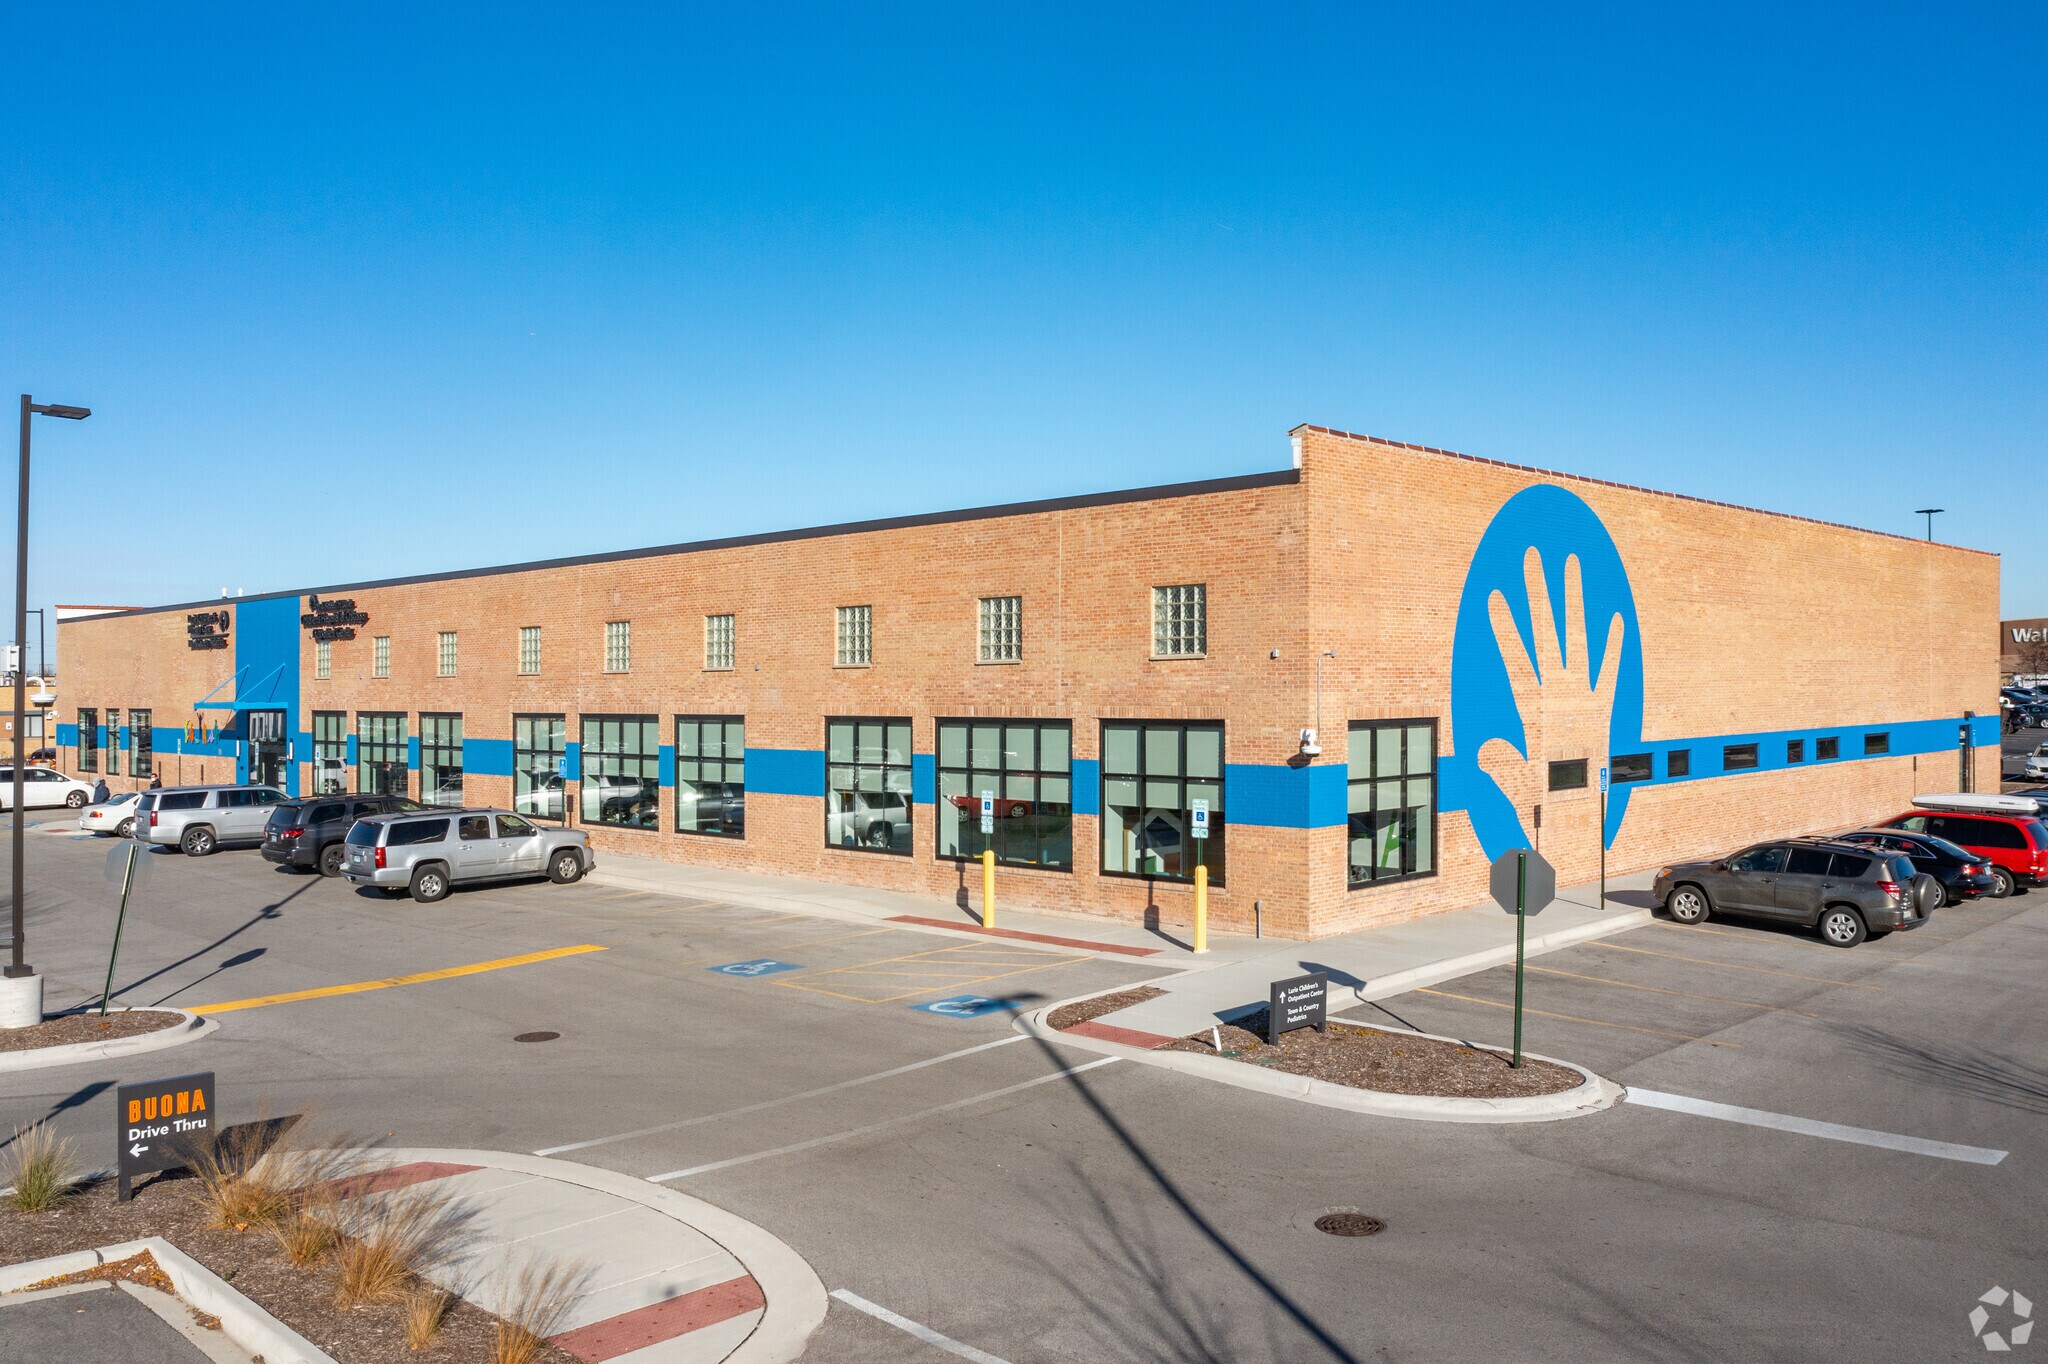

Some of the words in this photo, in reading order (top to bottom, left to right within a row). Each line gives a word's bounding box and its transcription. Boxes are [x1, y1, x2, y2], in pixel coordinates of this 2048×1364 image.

[2012, 628, 2048, 643] Wal
[1288, 986, 1298, 994] Lurie
[1299, 982, 1318, 991] Children's
[1288, 992, 1310, 1002] Outpatient
[1303, 1003, 1319, 1011] Country
[1287, 1014, 1307, 1023] Pediatrics
[128, 1089, 206, 1123] BUONA
[128, 1125, 170, 1141] Drive
[173, 1118, 207, 1133] Thru
